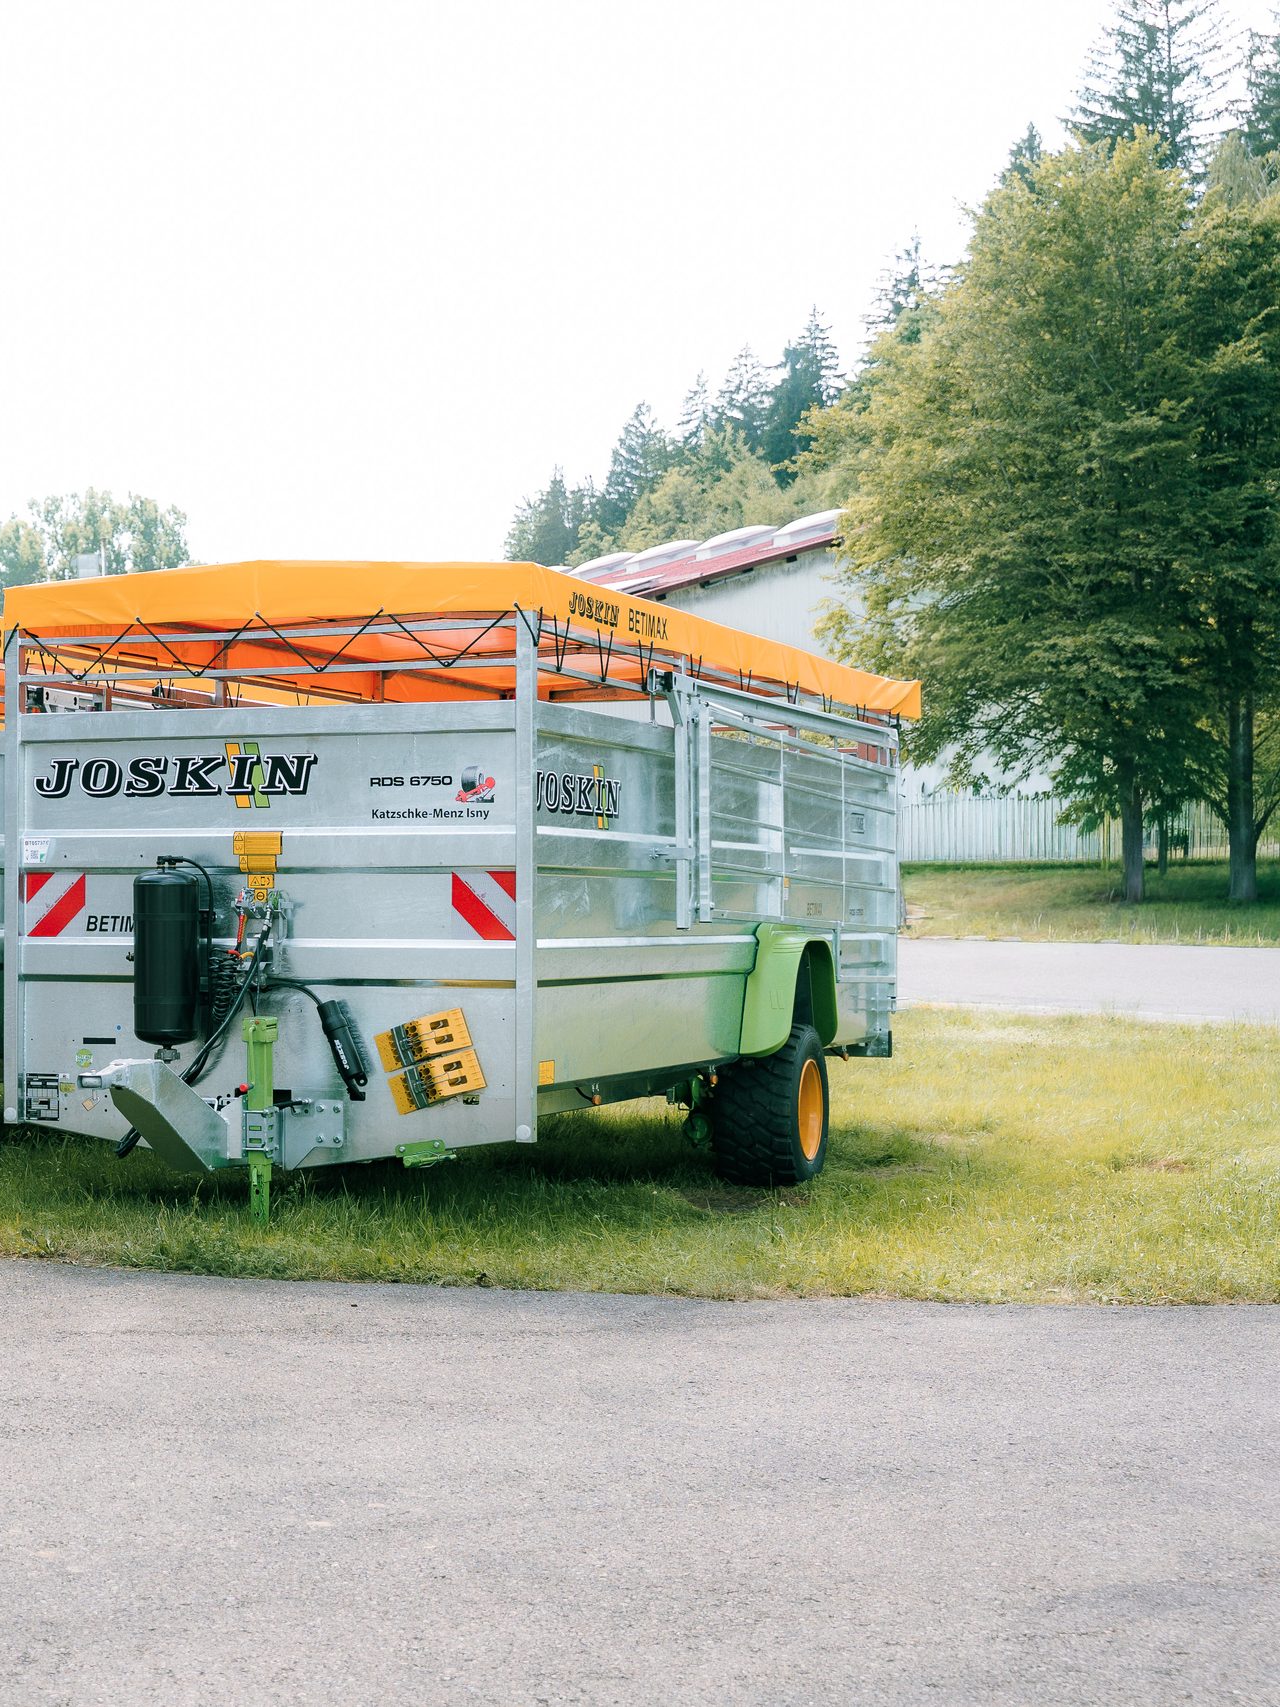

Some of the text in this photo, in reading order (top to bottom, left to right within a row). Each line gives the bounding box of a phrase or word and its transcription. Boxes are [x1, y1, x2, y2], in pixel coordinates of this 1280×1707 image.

[569, 592, 668, 640] JOSKIN BETIMAX
[33, 753, 318, 798] JOSKIN
[370, 775, 453, 787] RDS 6750
[371, 808, 490, 821] Katzschke-Menz Isny
